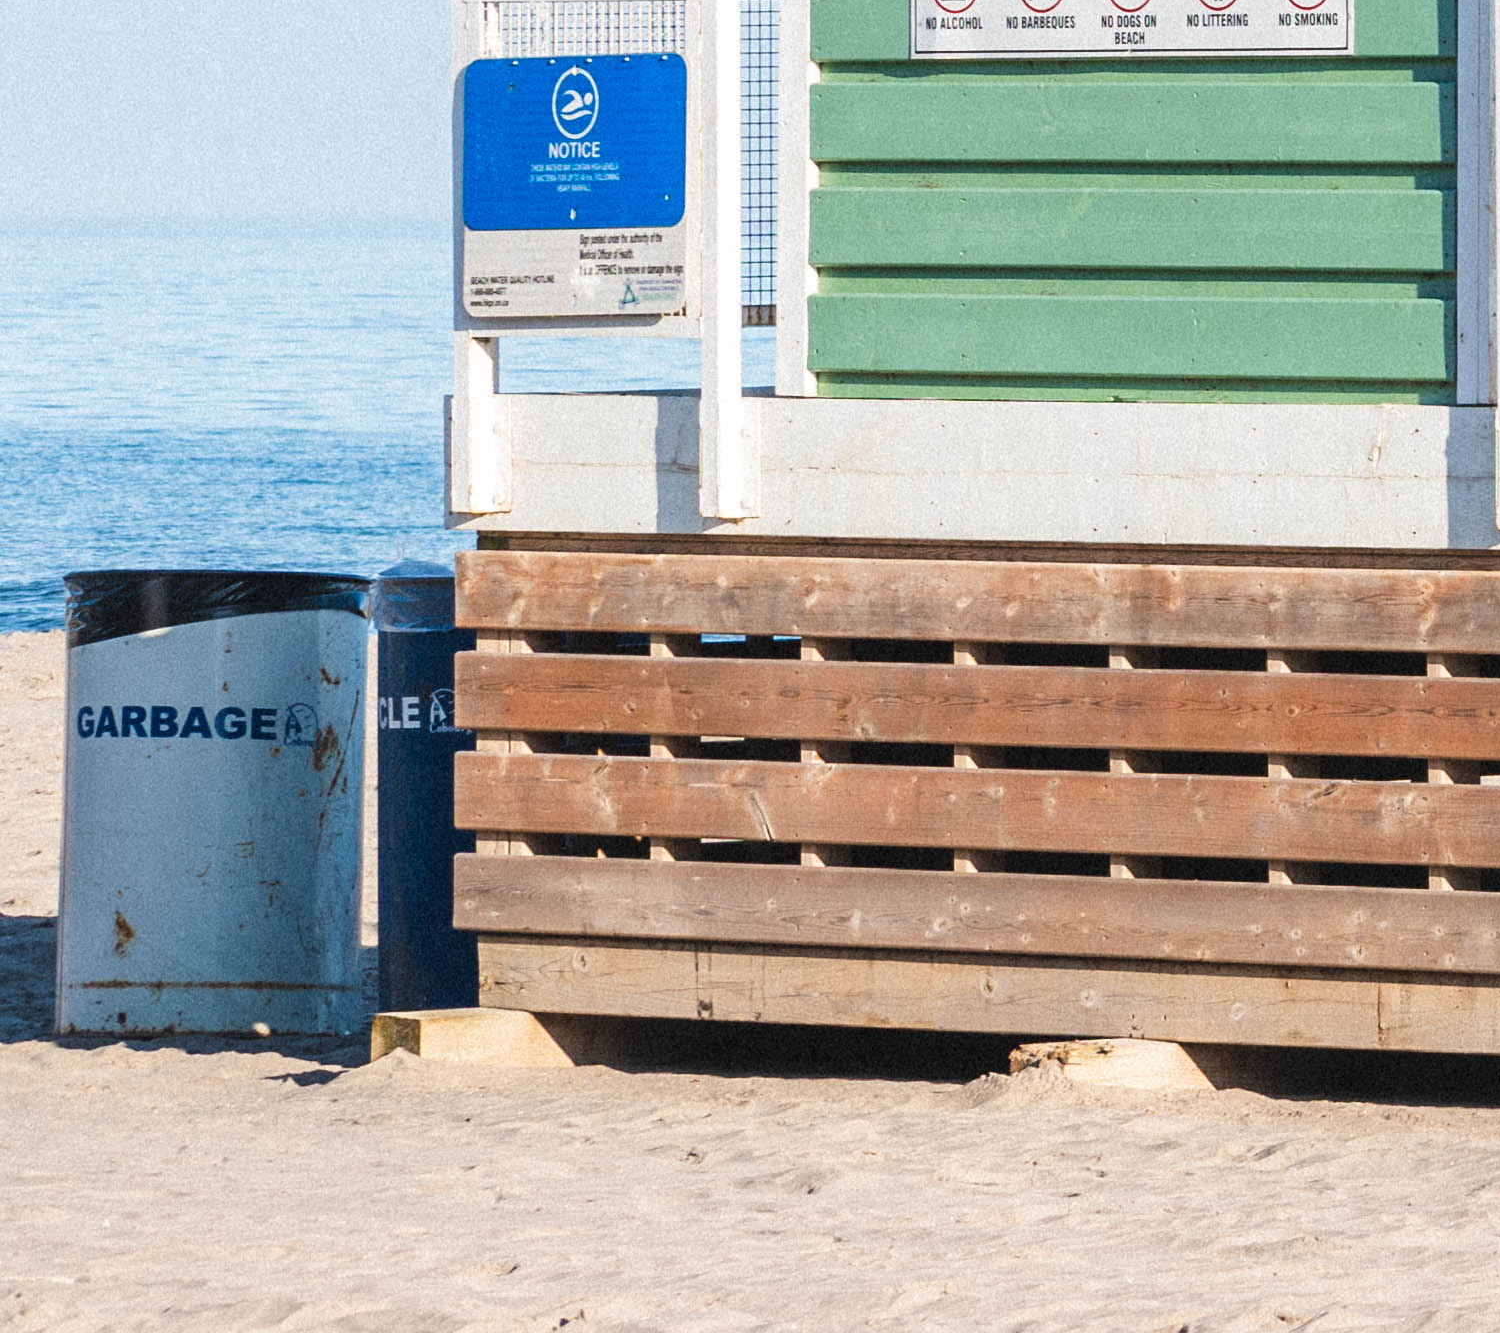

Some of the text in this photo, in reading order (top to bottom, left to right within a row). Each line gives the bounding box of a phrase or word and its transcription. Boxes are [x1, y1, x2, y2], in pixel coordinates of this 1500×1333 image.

[926, 16, 983, 30] NO ALCOHOL
[1006, 15, 1076, 29] NO BARBEQUES
[1101, 14, 1157, 28] NO DOGS ON
[1186, 13, 1249, 27] NO LITTERING
[1278, 12, 1338, 26] NO SMOKING
[1114, 31, 1145, 45] BEACH
[548, 141, 600, 159] NOTICE
[77, 705, 278, 740] GARBAGE
